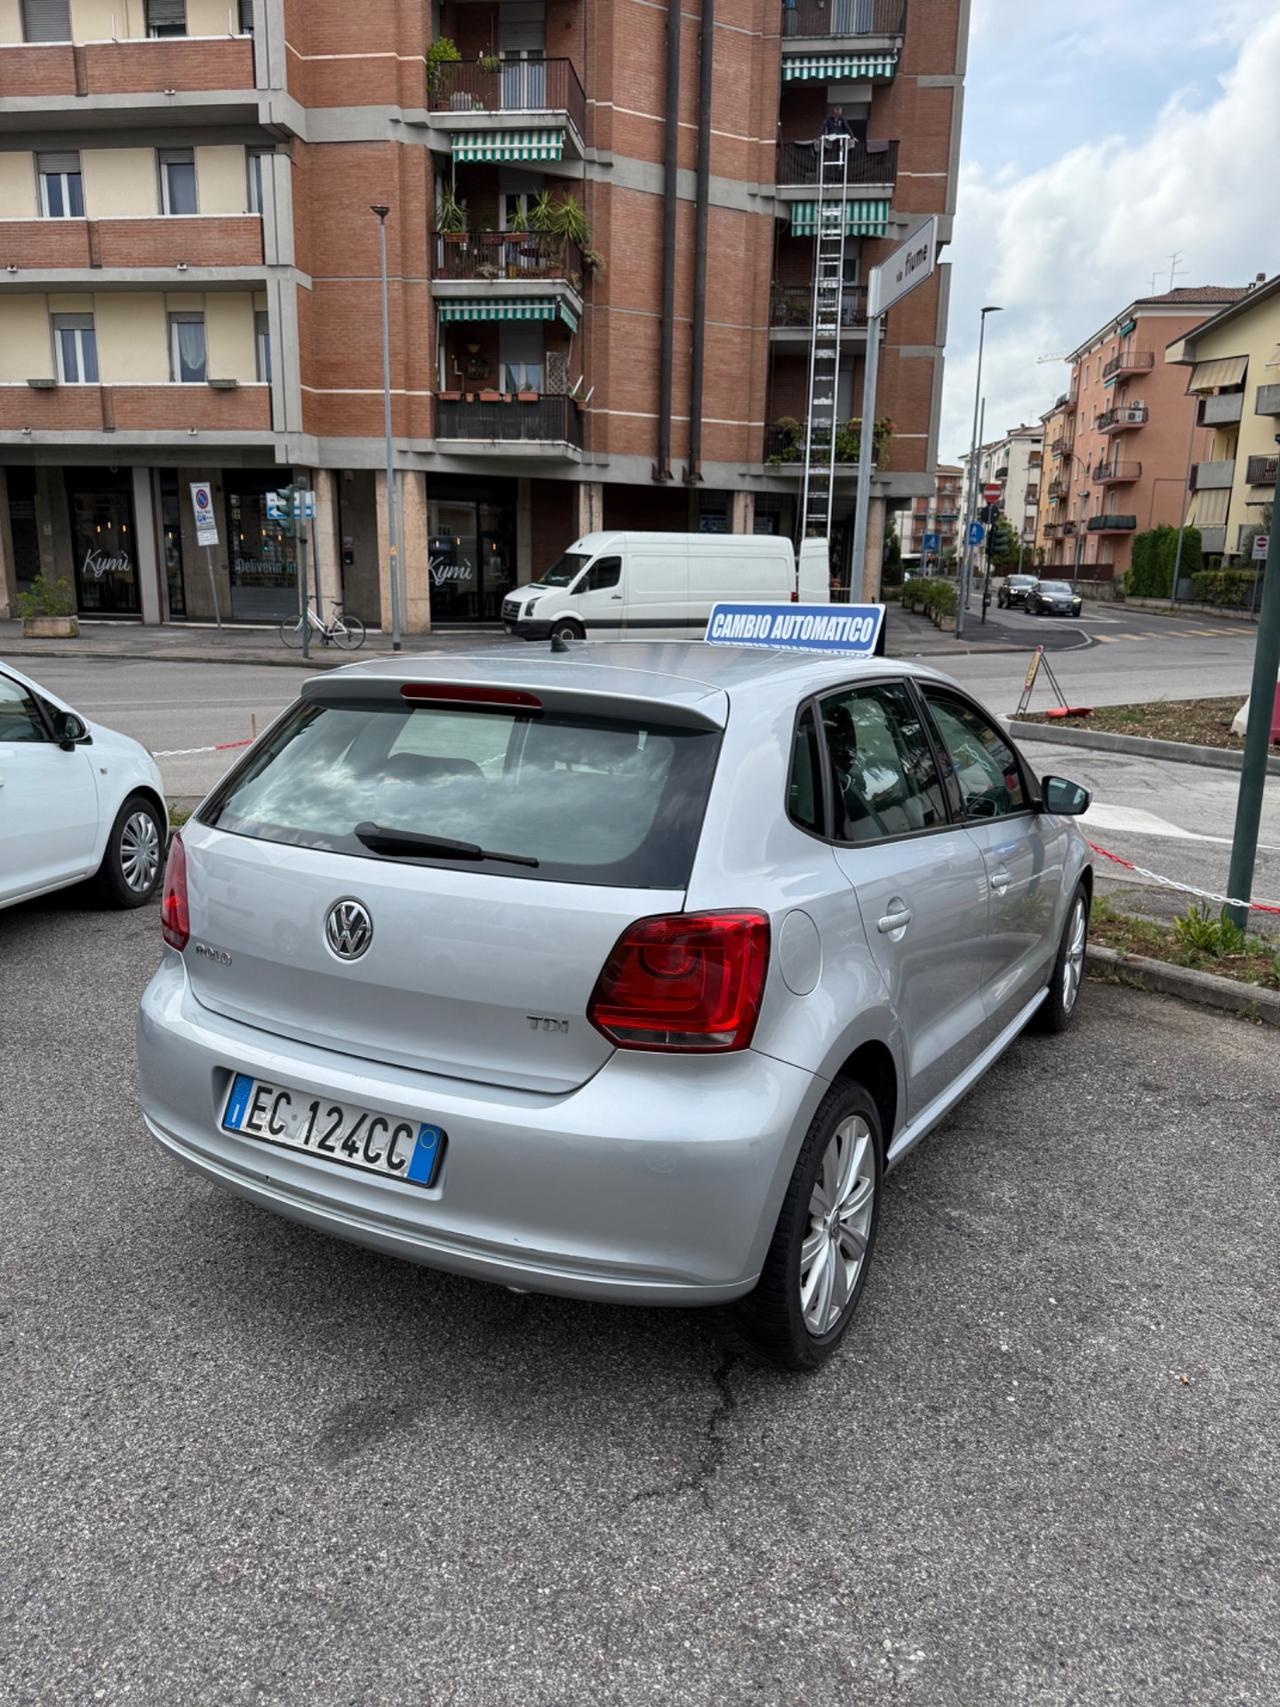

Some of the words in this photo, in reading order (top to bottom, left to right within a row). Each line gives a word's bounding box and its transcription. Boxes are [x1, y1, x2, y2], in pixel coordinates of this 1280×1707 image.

[905, 244, 928, 277] fiume
[83, 549, 130, 577] Kymì
[428, 556, 472, 585] Kymì
[711, 613, 771, 639] CAMBIO
[770, 615, 874, 643] AUTOMATICO
[526, 1015, 569, 1034] TDI
